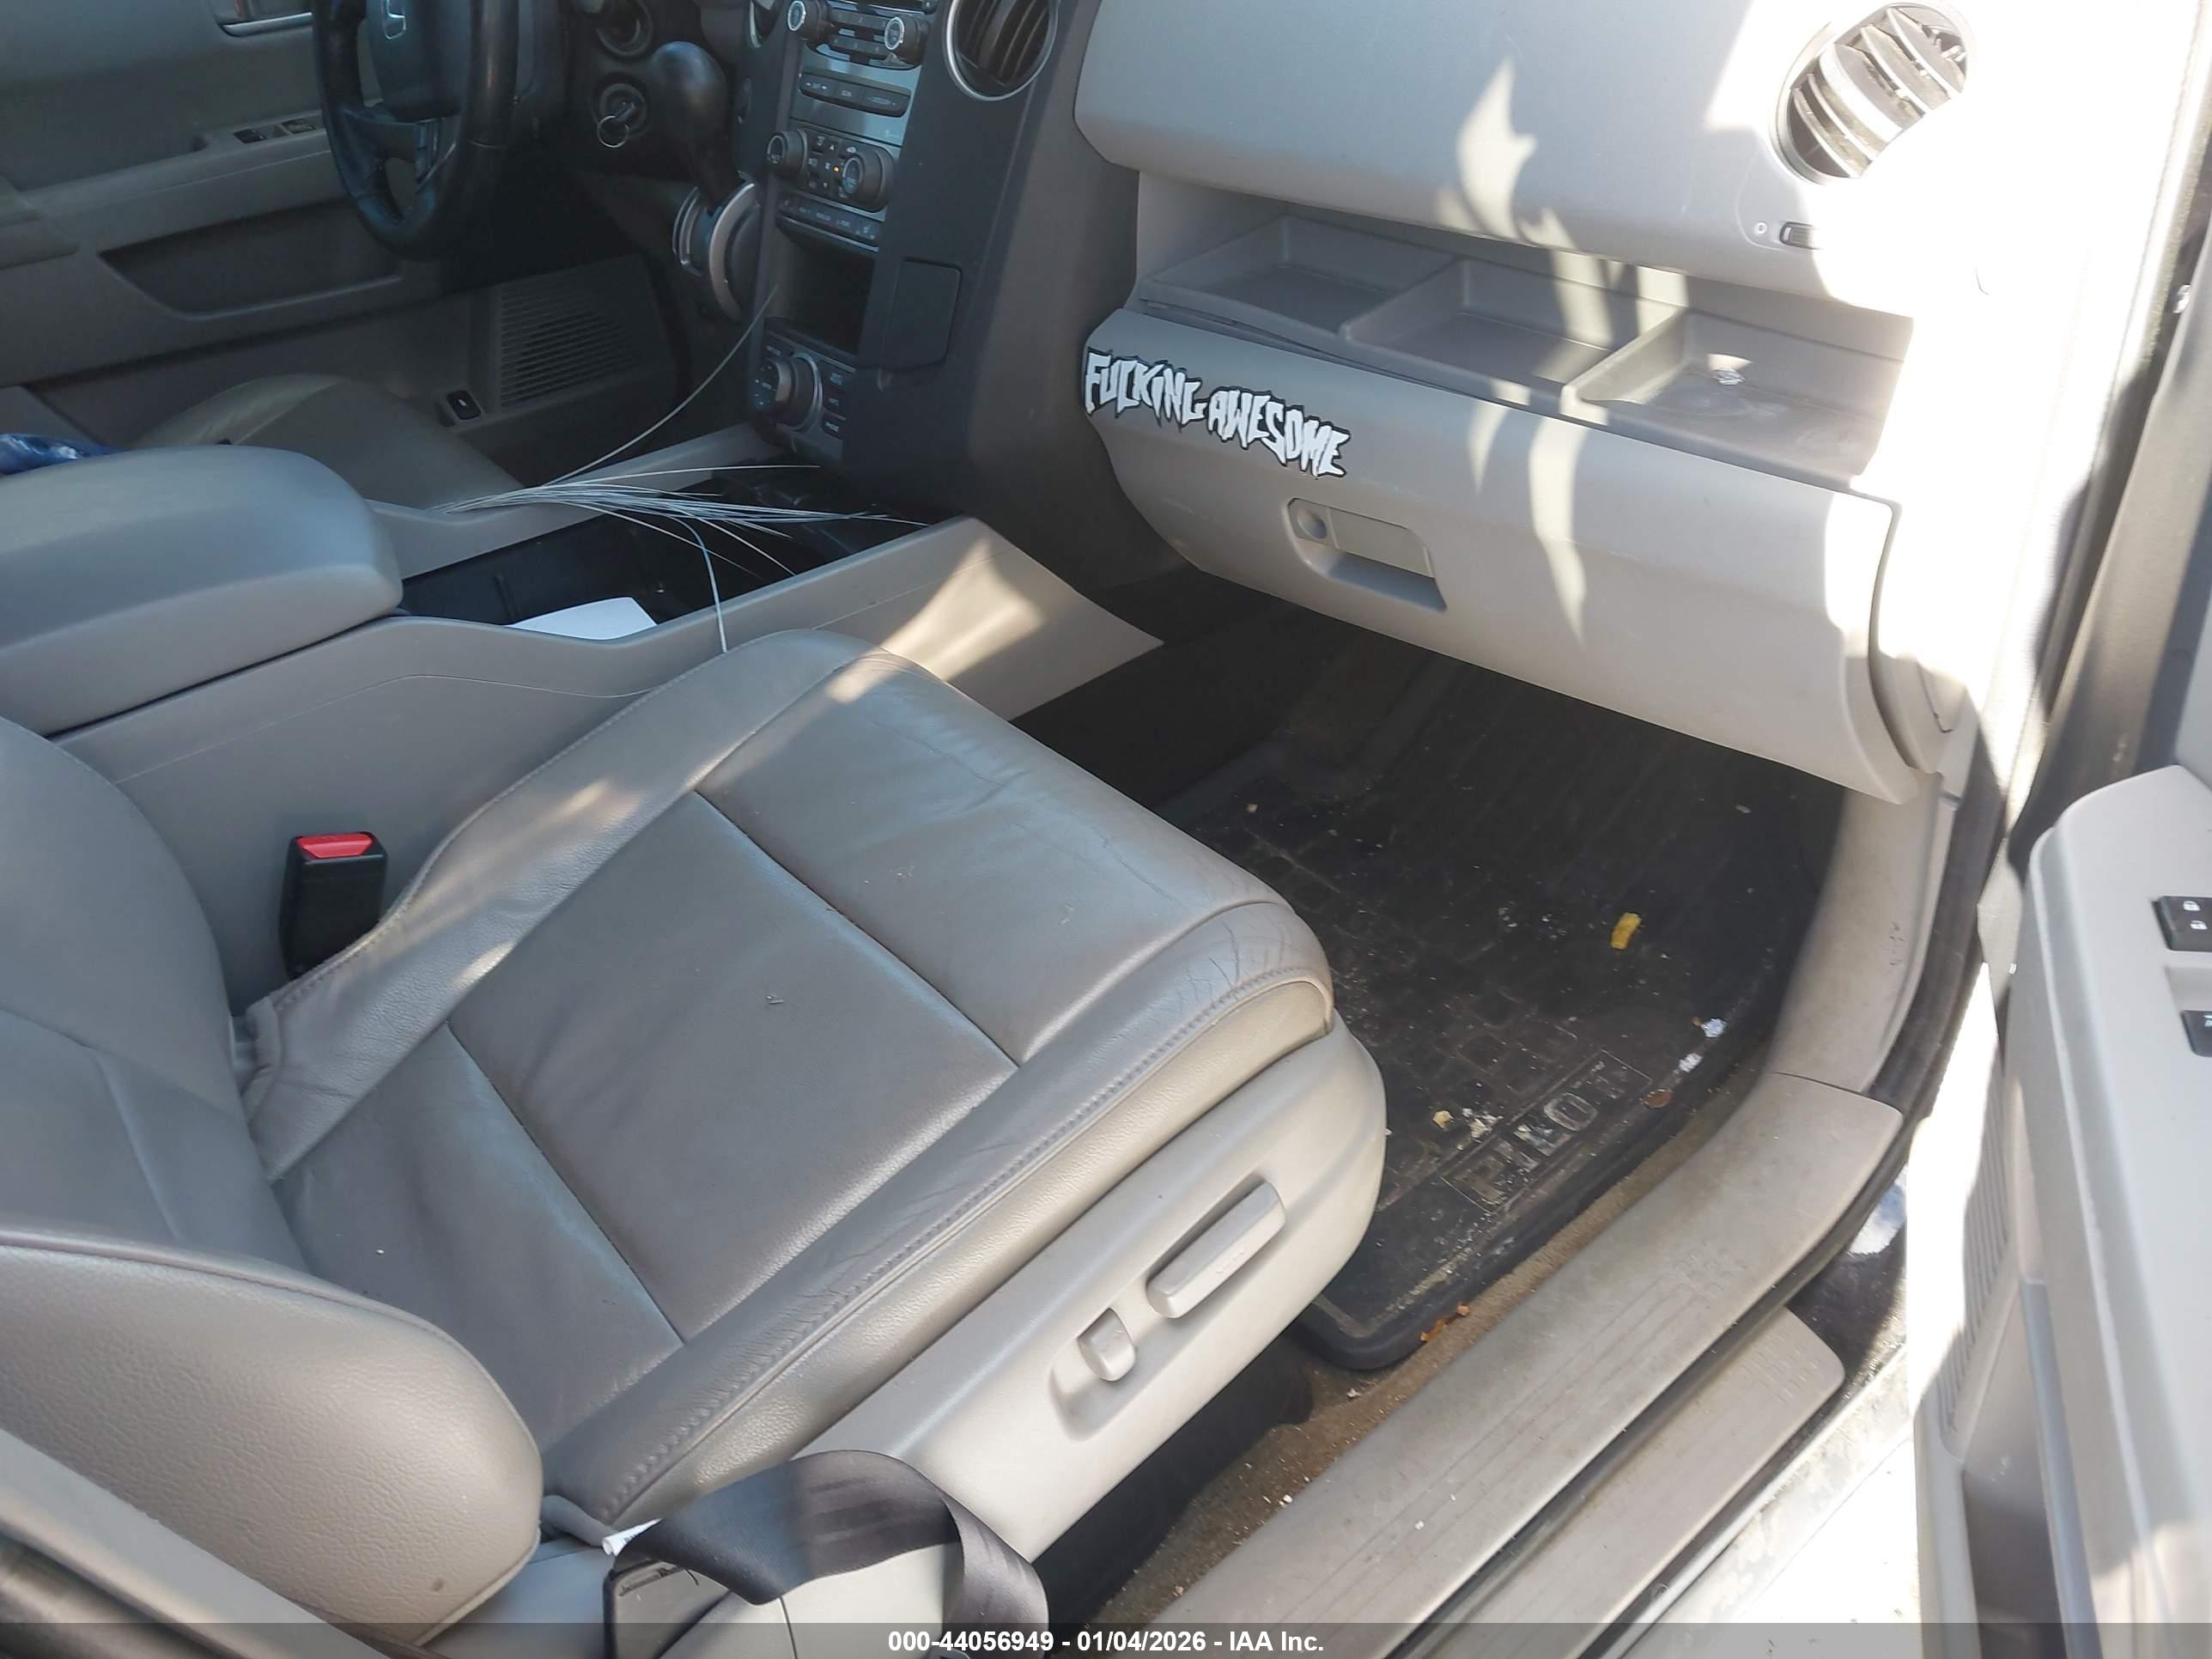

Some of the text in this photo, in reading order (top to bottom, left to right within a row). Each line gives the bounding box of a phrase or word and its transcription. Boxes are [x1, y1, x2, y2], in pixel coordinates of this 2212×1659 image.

[1084, 348, 1352, 477] FUCKING AWESOME
[1455, 1060, 1626, 1205] PILOT
